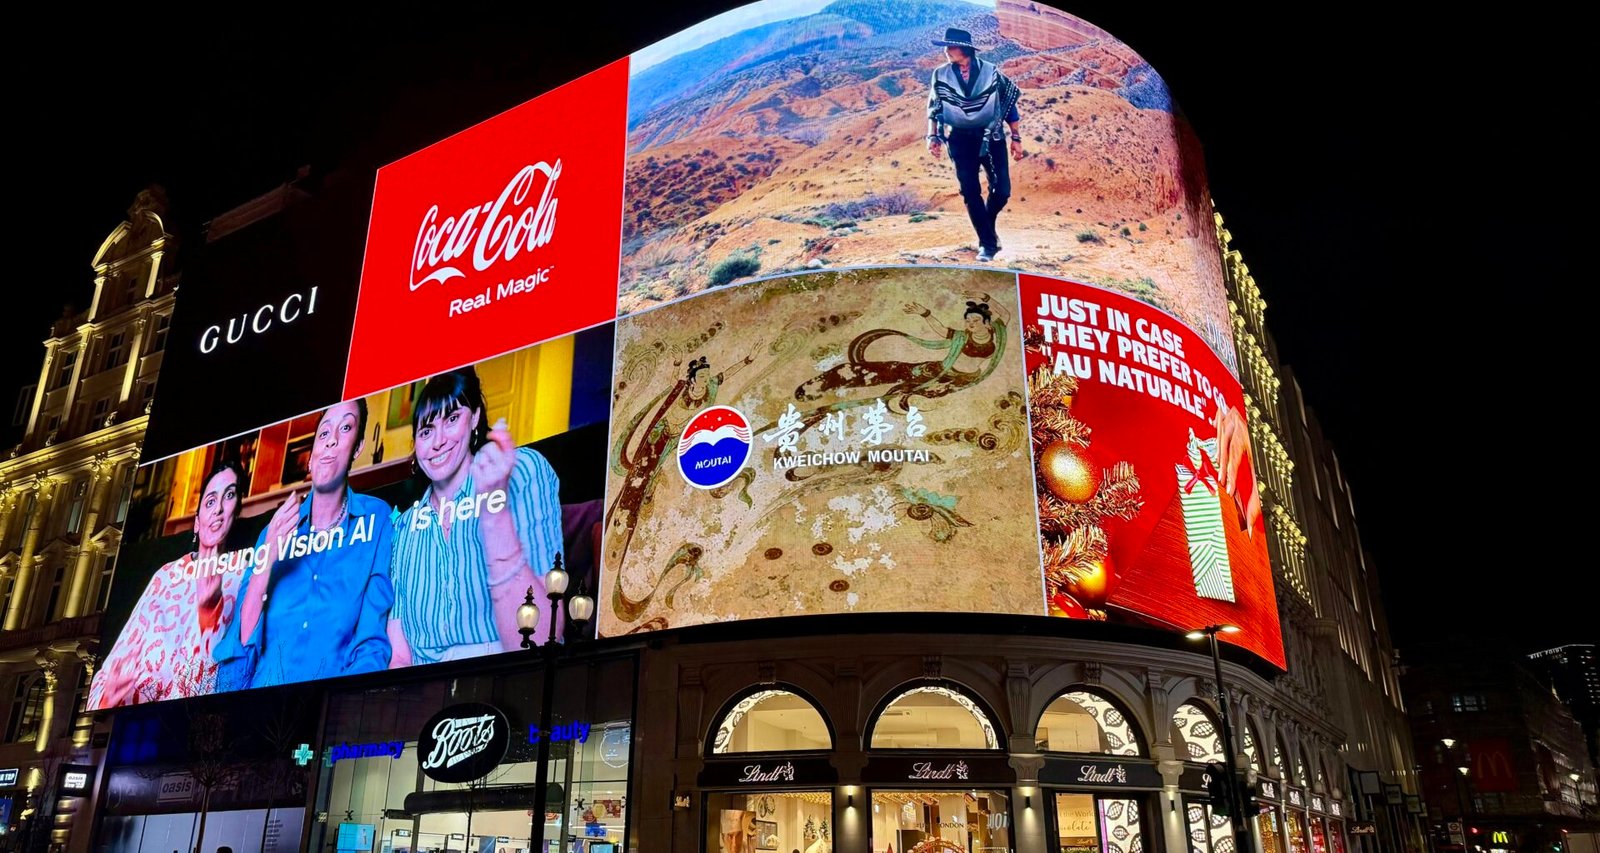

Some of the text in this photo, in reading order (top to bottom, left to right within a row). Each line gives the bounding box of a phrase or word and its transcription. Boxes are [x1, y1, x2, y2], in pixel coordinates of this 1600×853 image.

[408, 158, 561, 291] Coca-Cola
[449, 293, 491, 317] Real
[199, 286, 318, 353] GUCCI
[1036, 293, 1185, 359] JUST IN CASE
[1037, 319, 1110, 354] THEY
[1117, 336, 1193, 387] PREFER
[1193, 371, 1212, 400] TO
[694, 456, 732, 472] MOUTAI
[773, 450, 930, 470] KWEICHOW MOUTAI
[171, 489, 507, 584] Samsung Vision AI is here
[422, 715, 496, 770] Boots
[528, 720, 591, 744] bauty
[331, 741, 405, 763] pharmacy
[739, 765, 784, 782] Lindt
[908, 762, 956, 779] Lindt
[1077, 765, 1116, 783] Lindt
[162, 779, 192, 793] oasis
